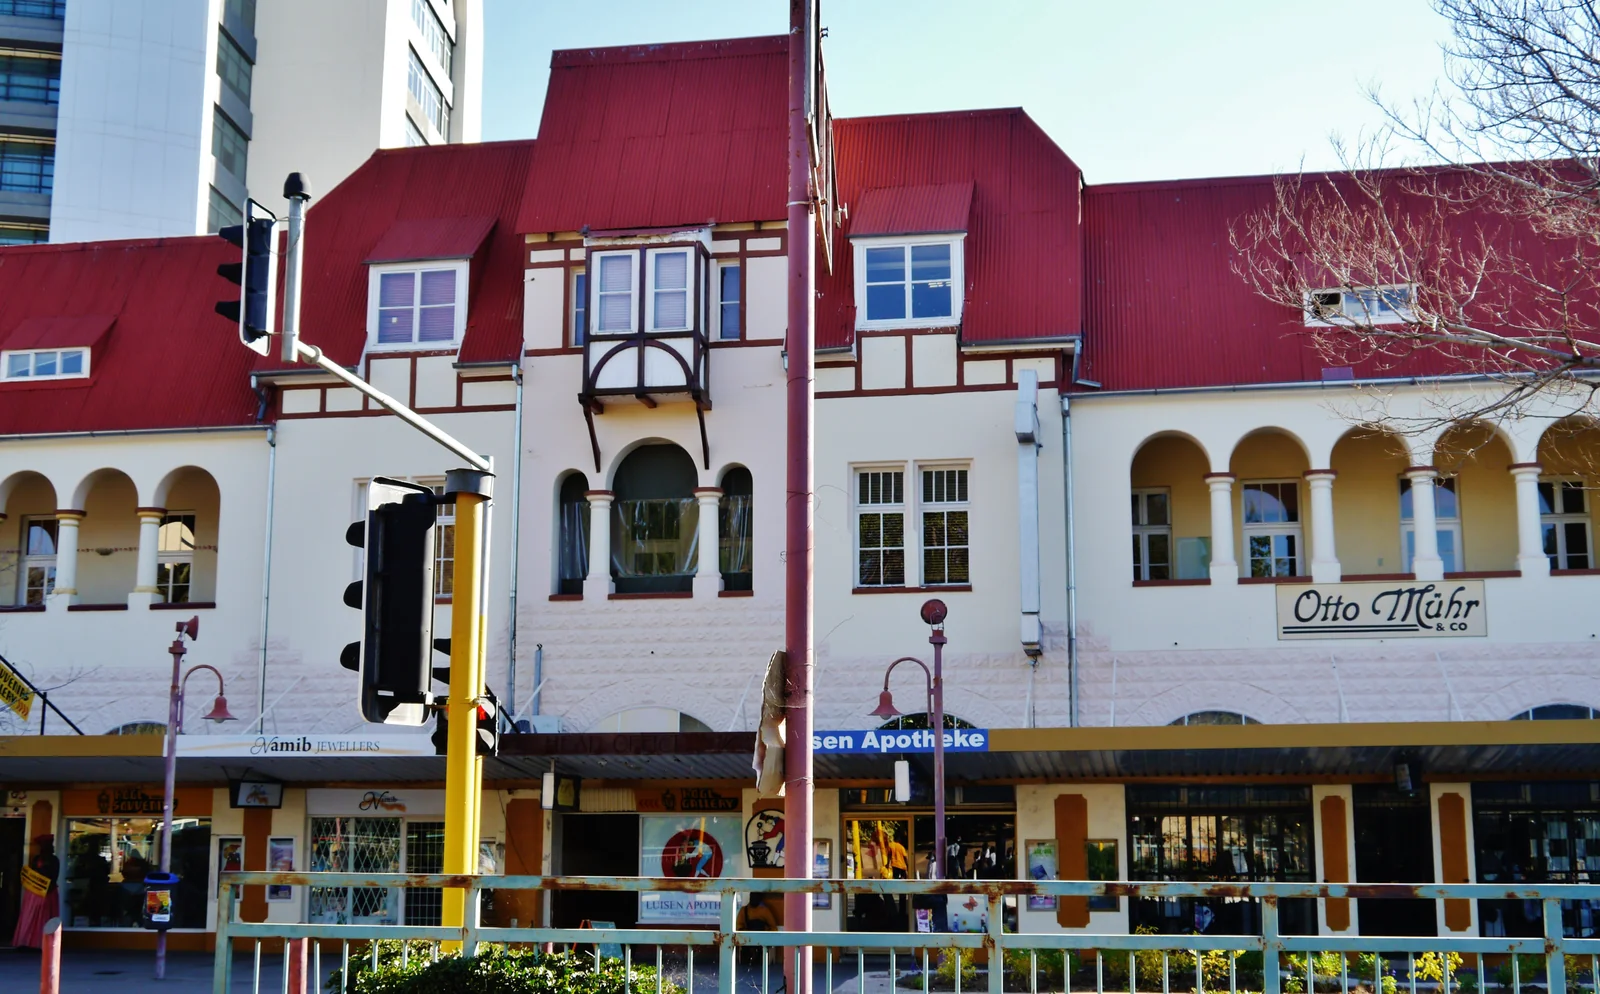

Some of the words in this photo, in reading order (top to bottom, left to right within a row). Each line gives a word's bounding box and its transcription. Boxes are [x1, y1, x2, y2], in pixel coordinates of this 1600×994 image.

[1294, 589, 1360, 622] Otto
[1371, 584, 1480, 629] Mühr
[1436, 622, 1445, 631] &
[250, 736, 312, 754] Namib
[315, 741, 380, 753] JEWELLERS
[861, 729, 985, 752] Apotheke
[646, 900, 682, 910] LUISEN
